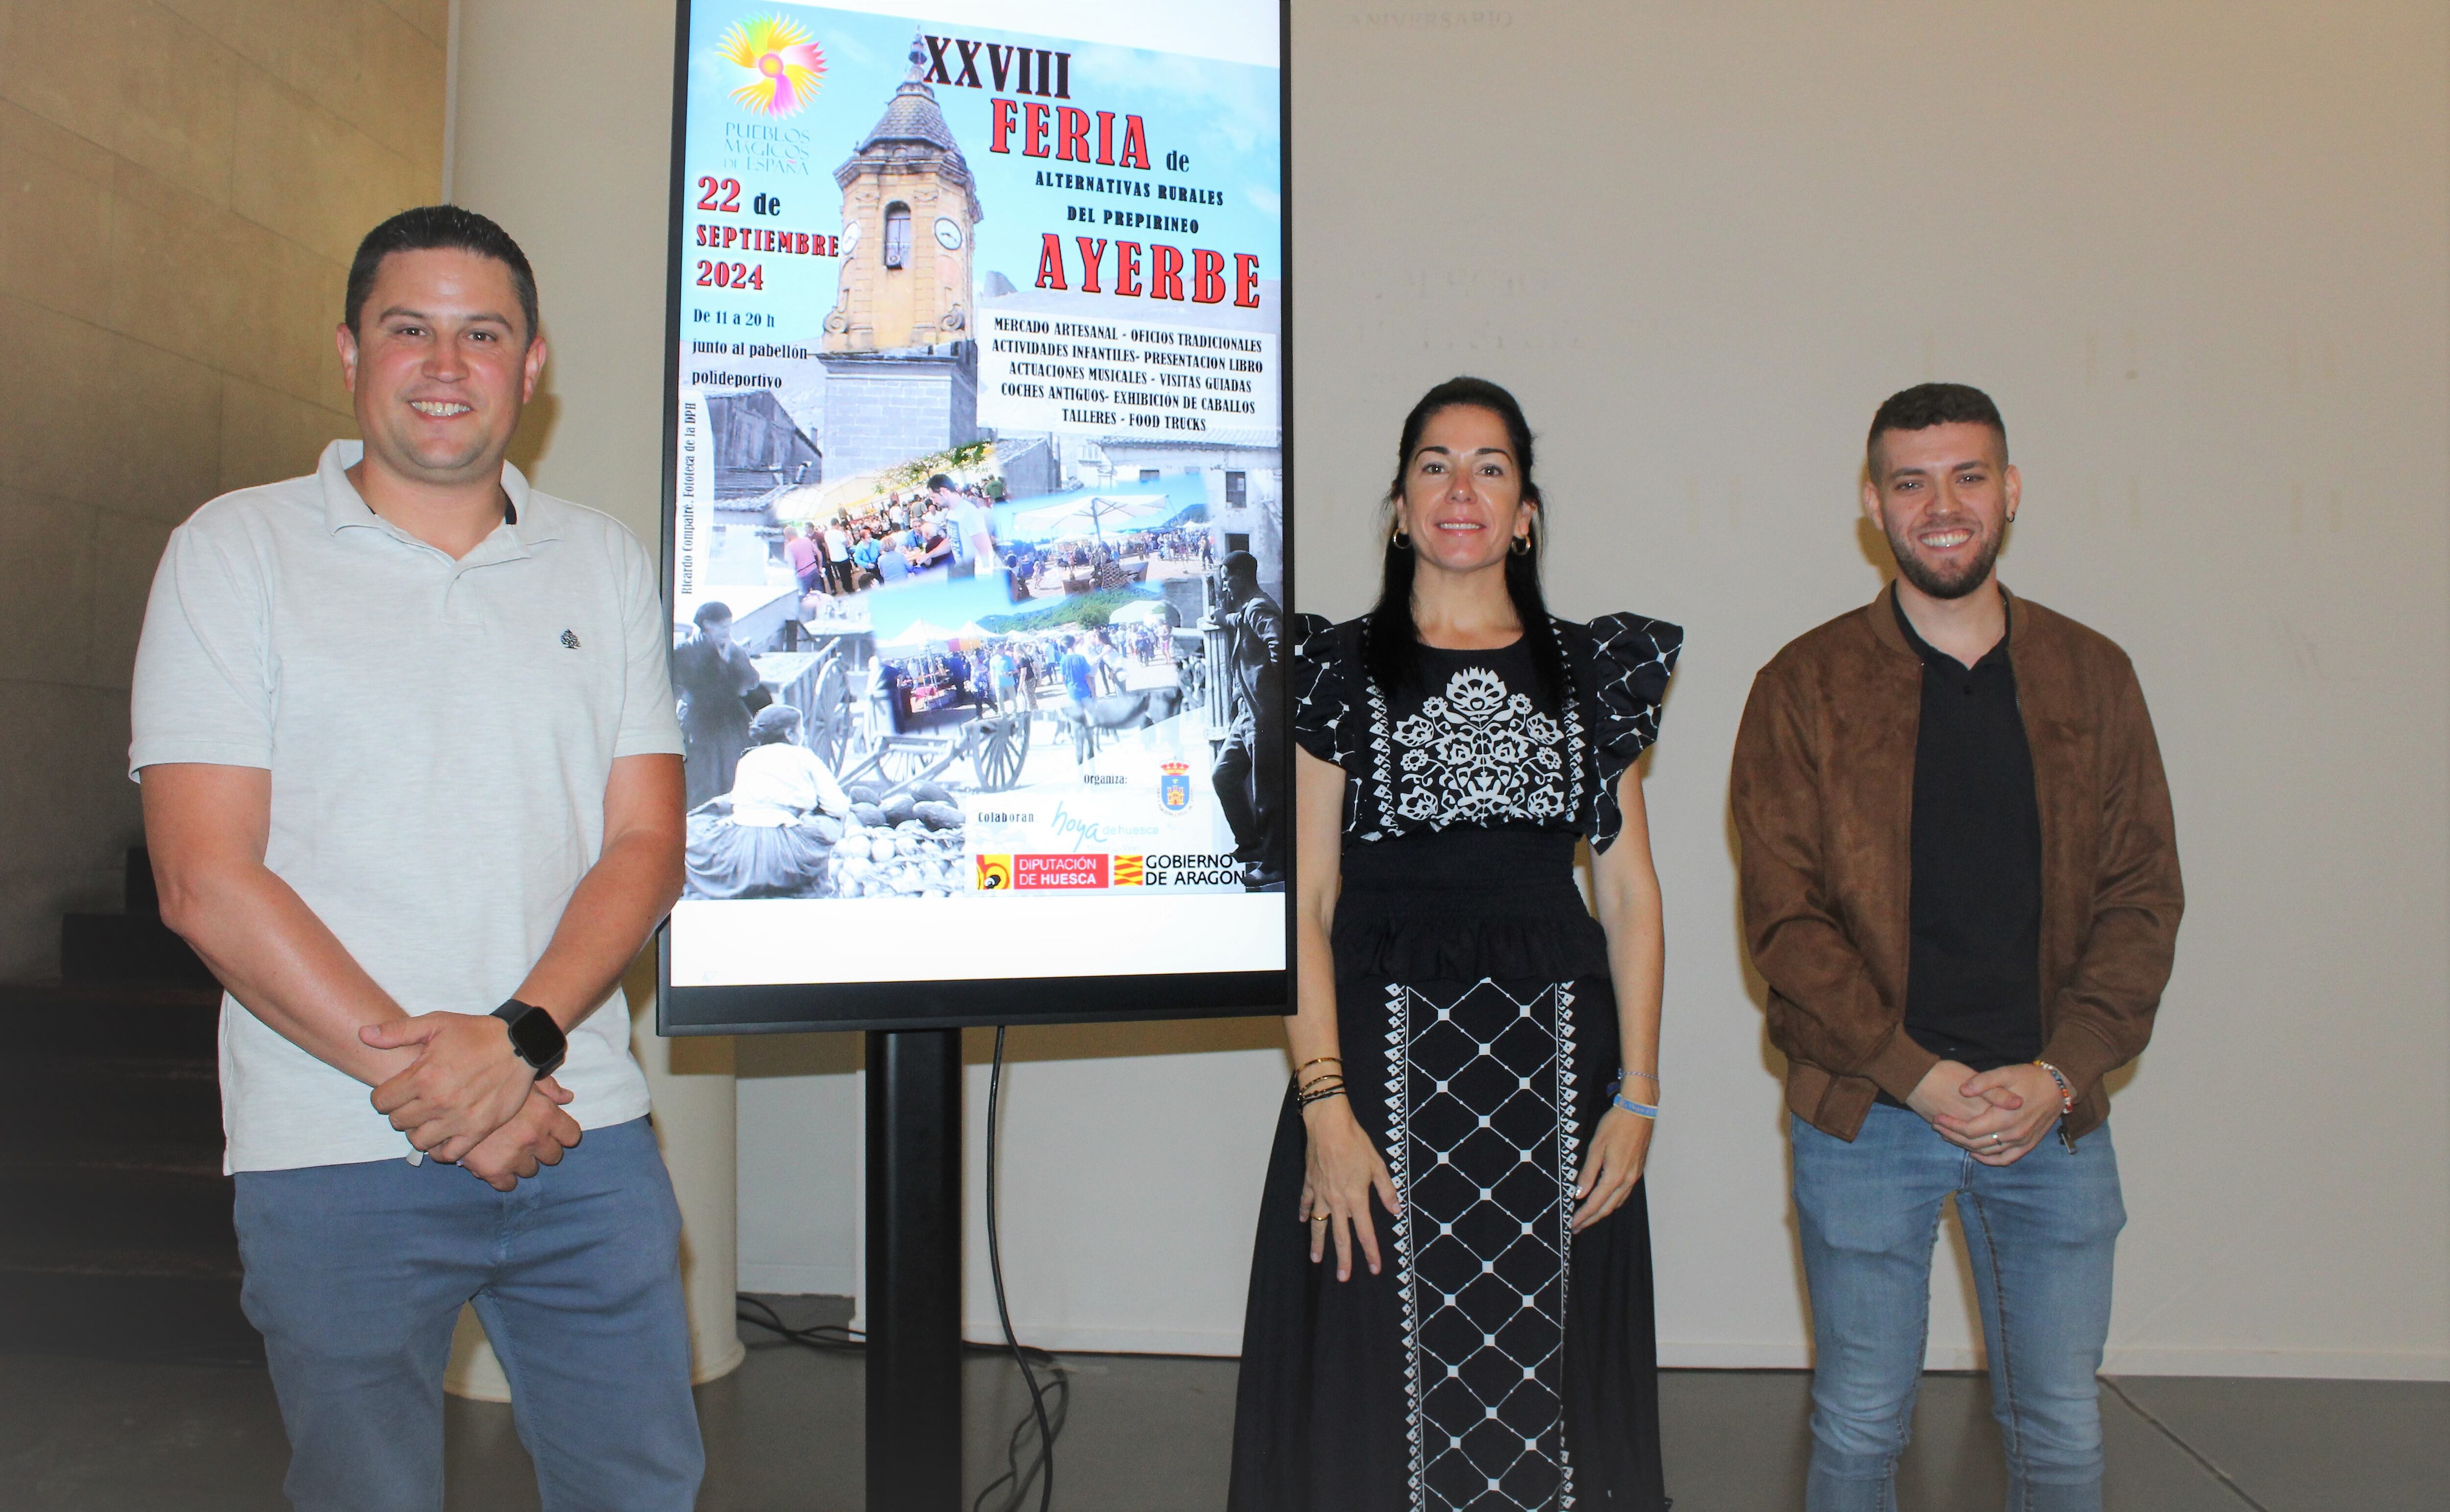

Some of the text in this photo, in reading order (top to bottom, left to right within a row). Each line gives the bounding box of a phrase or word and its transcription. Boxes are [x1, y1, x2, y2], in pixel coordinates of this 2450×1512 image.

[923, 35, 1072, 99] XXVIII
[726, 122, 809, 144] PUEBLOS
[990, 98, 1190, 172] FERIA de
[747, 156, 808, 175] ESPAÑA
[697, 176, 781, 216] 22 de
[1035, 171, 1224, 206] ALTERNATIVAS RURALES
[1067, 205, 1200, 234] DEL PREPIRINEO
[696, 224, 839, 257] SEPTIEMBRE
[696, 260, 763, 291] 2024
[1035, 233, 1261, 309] AYERBE
[693, 308, 775, 327] De 11 a 20 h
[692, 338, 808, 360] junto al pabellón
[994, 317, 1050, 334] MERCADO
[1054, 322, 1118, 340] ARTESANAL
[1131, 329, 1174, 345] OFICIOS
[1177, 333, 1262, 353] TRADICIONALES
[992, 338, 1069, 357] ACTIVIDADES
[1144, 350, 1225, 370] PRESENTACION
[1229, 358, 1263, 373] LIBRO
[692, 370, 782, 389] polideportivo
[1009, 362, 1084, 380] ACTUACIONES
[1088, 367, 1147, 385] MUSICALES
[1159, 372, 1201, 389] VISITAS
[1205, 377, 1251, 393] GUIADAS
[1001, 382, 1044, 398] COCHES
[1114, 391, 1179, 408] EXHIBICIÓN
[1183, 396, 1197, 410] DE
[1201, 397, 1255, 414] CABALLOS
[685, 402, 696, 424] DPH
[1061, 408, 1117, 425] TALLERES
[1128, 413, 1160, 428] FOOD
[1164, 415, 1206, 431] TRUCKS
[683, 427, 695, 437] la
[683, 440, 695, 452] de
[683, 456, 695, 498] Fototeca
[681, 555, 692, 594] Ricardo
[1084, 774, 1127, 785] Organiza:
[1051, 800, 1107, 853] hoya
[1019, 856, 1097, 871] DIPUTACIÓN
[1146, 854, 1233, 869] GOBIERNO
[1019, 873, 1097, 885] DE HUESCA
[1146, 870, 1245, 885] DE ARAGON
